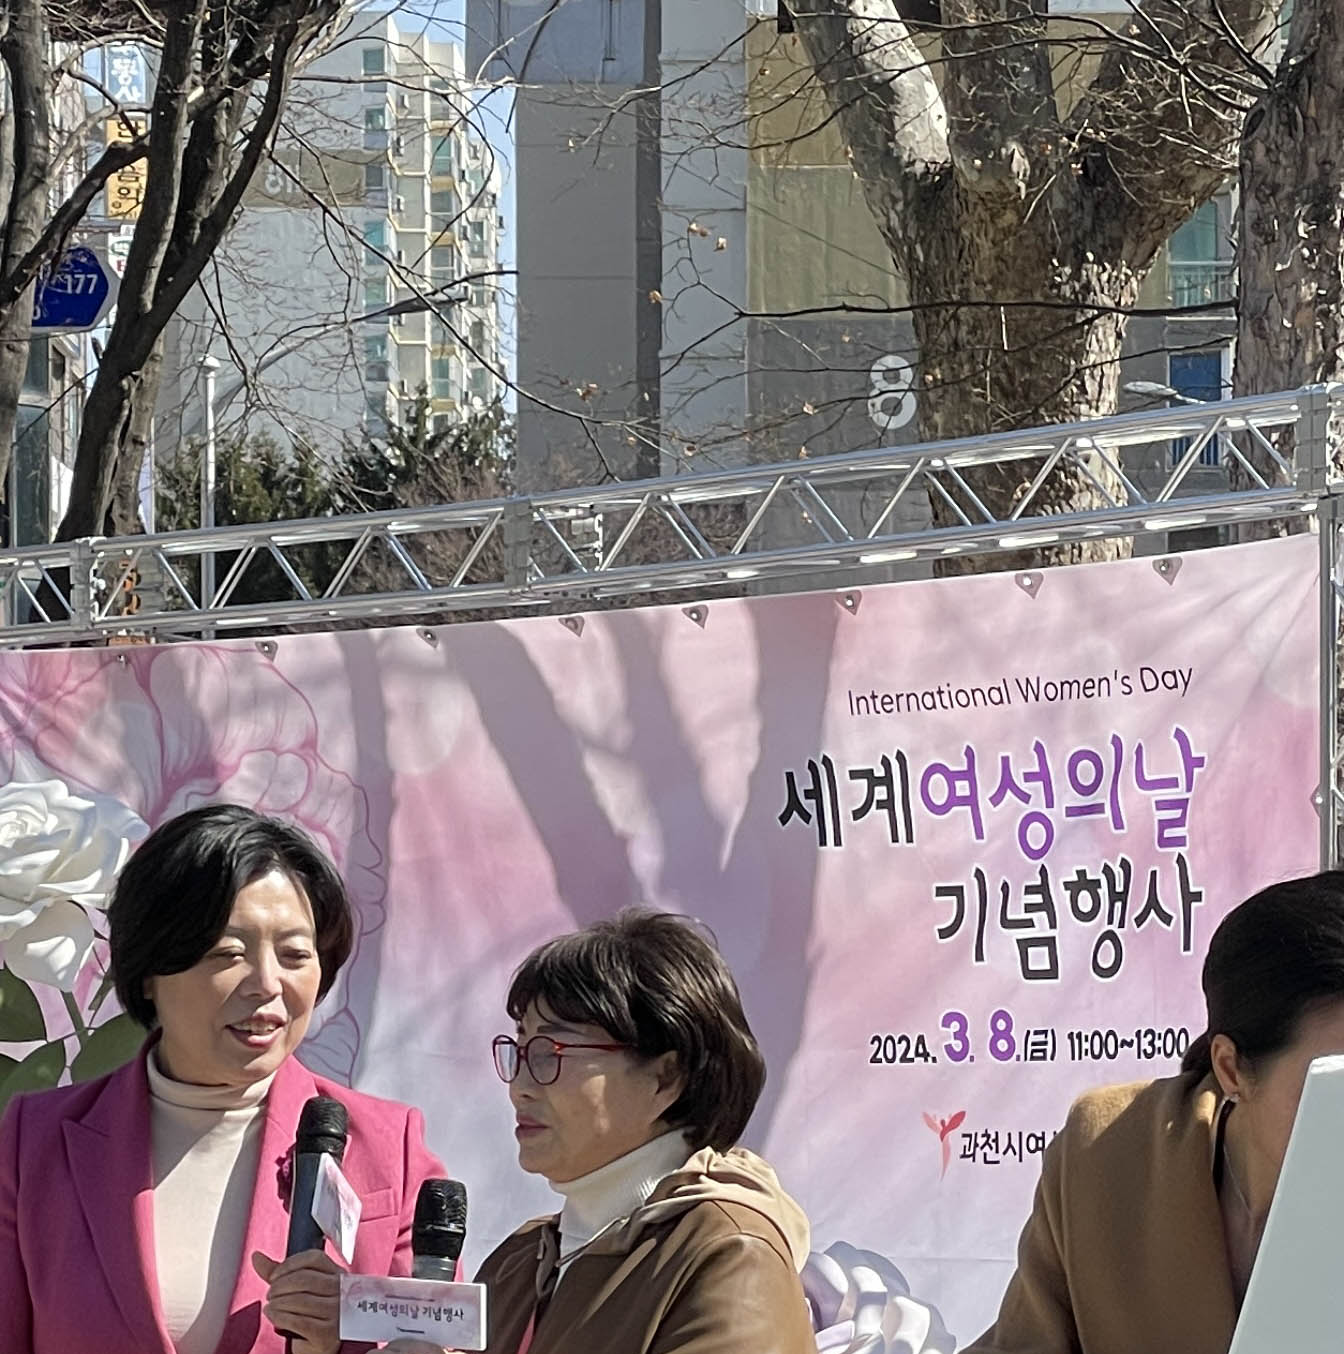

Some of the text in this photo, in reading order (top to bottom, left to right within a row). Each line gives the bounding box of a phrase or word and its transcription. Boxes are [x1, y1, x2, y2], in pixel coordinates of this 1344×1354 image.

[66, 273, 98, 295] 177
[867, 355, 916, 430] 8
[847, 664, 1194, 717] International Women's Day
[777, 726, 1205, 861] 세계여성의날
[934, 852, 1204, 981] 기념행사
[1068, 1027, 1190, 1062] 11:00~13:00
[959, 1129, 1056, 1165] 과천시여
